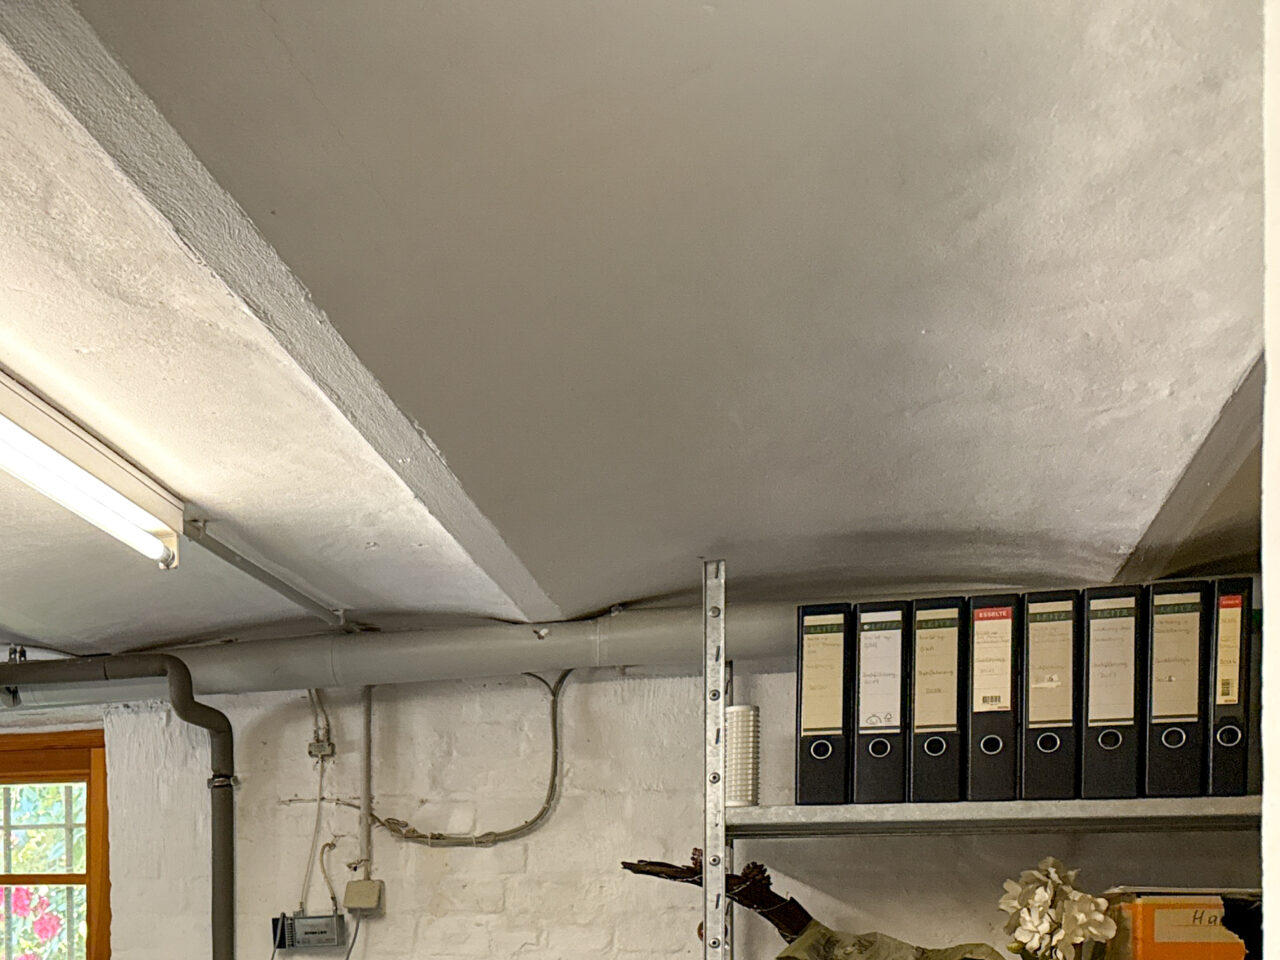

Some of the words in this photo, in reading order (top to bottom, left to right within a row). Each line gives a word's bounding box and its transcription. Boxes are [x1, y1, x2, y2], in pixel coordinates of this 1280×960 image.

[979, 610, 1008, 618] ESSELTE
[1035, 613, 1066, 621] LEITZ
[1097, 609, 1129, 618] LEITZ
